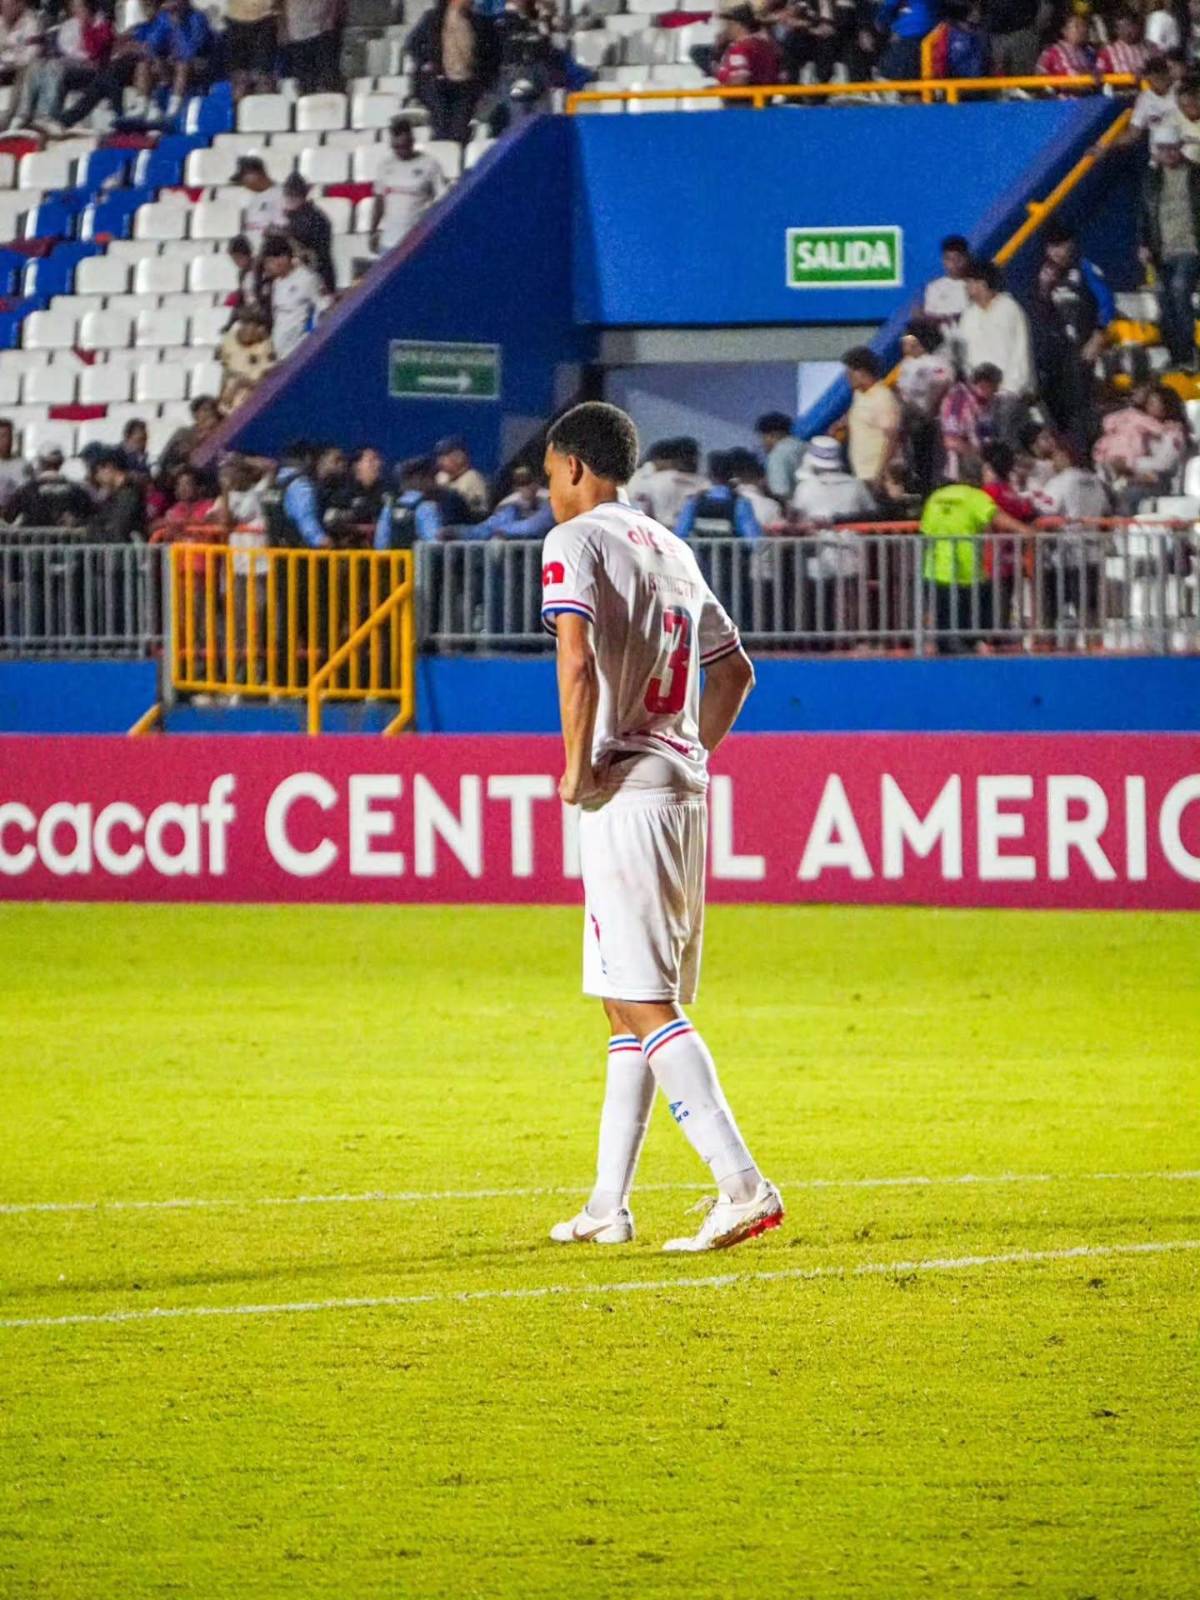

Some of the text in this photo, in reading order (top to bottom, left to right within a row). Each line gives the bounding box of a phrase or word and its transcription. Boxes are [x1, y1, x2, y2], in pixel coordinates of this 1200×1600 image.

[797, 240, 891, 269] SALIDA
[644, 606, 693, 714] 3
[264, 772, 766, 881] CENTL
